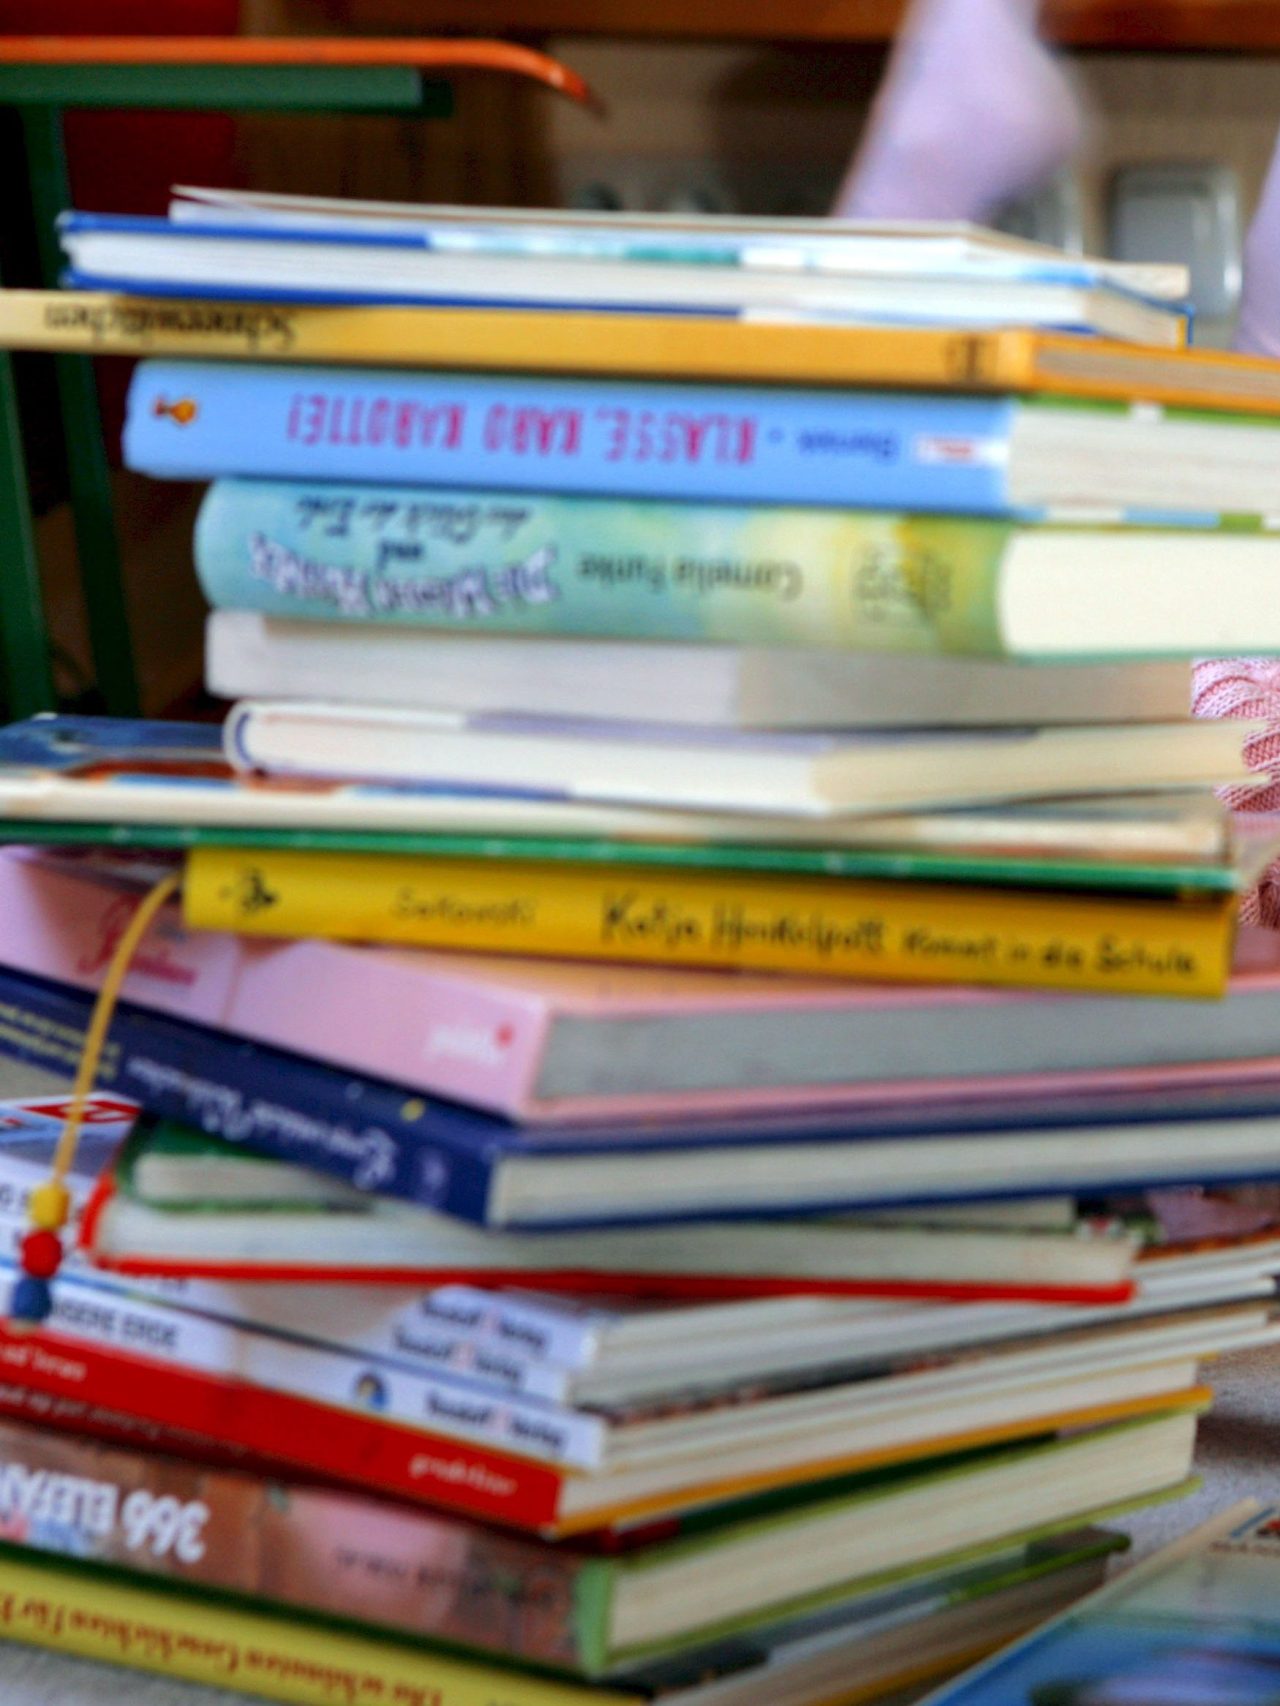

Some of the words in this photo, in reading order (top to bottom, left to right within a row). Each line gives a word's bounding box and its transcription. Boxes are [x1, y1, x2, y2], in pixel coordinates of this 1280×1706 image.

[286, 393, 468, 451] KAROTTE!
[483, 401, 583, 455] KARO
[674, 556, 804, 601] Cornelia
[600, 891, 701, 947] Katja
[1096, 934, 1196, 973] Schule
[122, 1488, 211, 1566] 366
